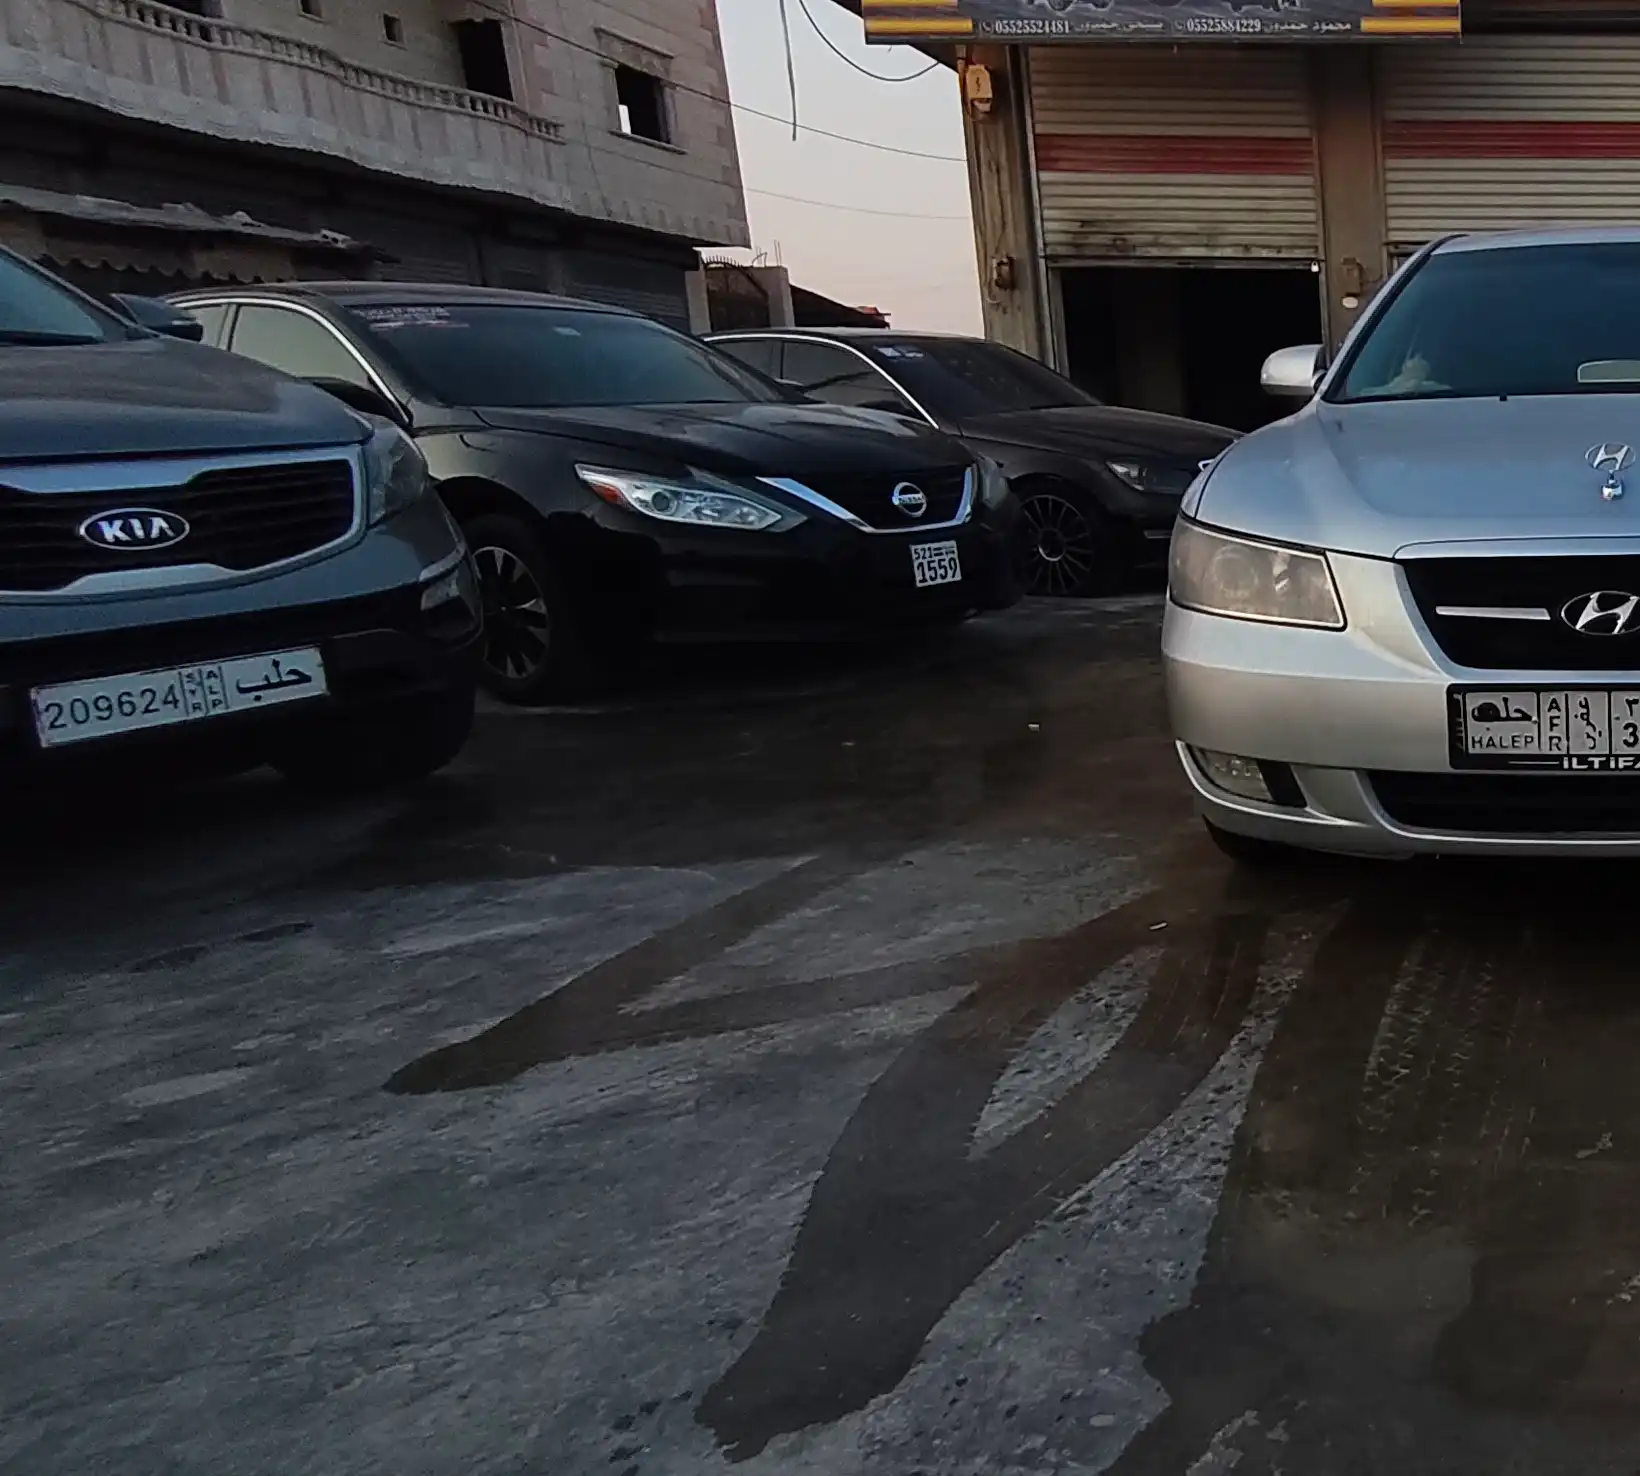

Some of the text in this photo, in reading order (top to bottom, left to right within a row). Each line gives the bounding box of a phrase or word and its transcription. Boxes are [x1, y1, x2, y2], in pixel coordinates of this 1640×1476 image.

[96, 517, 176, 542] KIA
[917, 557, 957, 583] 1559
[235, 658, 313, 702] حلب
[45, 684, 179, 730] 209624
[1547, 697, 1562, 751] AFR
[1471, 734, 1535, 749] HALEP
